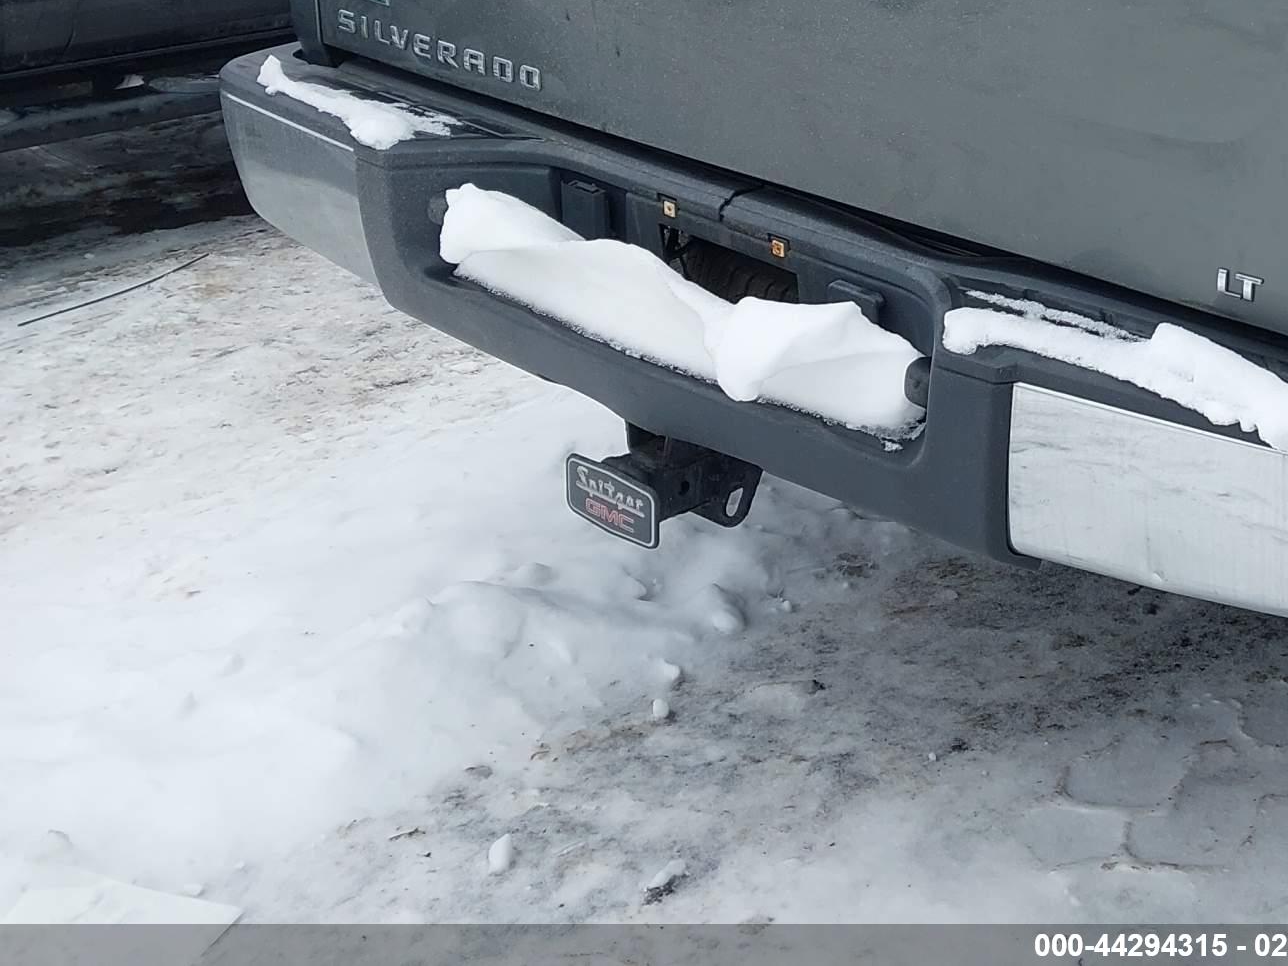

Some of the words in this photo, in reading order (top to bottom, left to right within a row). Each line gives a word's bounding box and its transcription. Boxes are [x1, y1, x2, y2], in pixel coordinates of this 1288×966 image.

[337, 9, 543, 91] SILVERADO
[1217, 268, 1263, 301] LT
[586, 498, 634, 533] GMC
